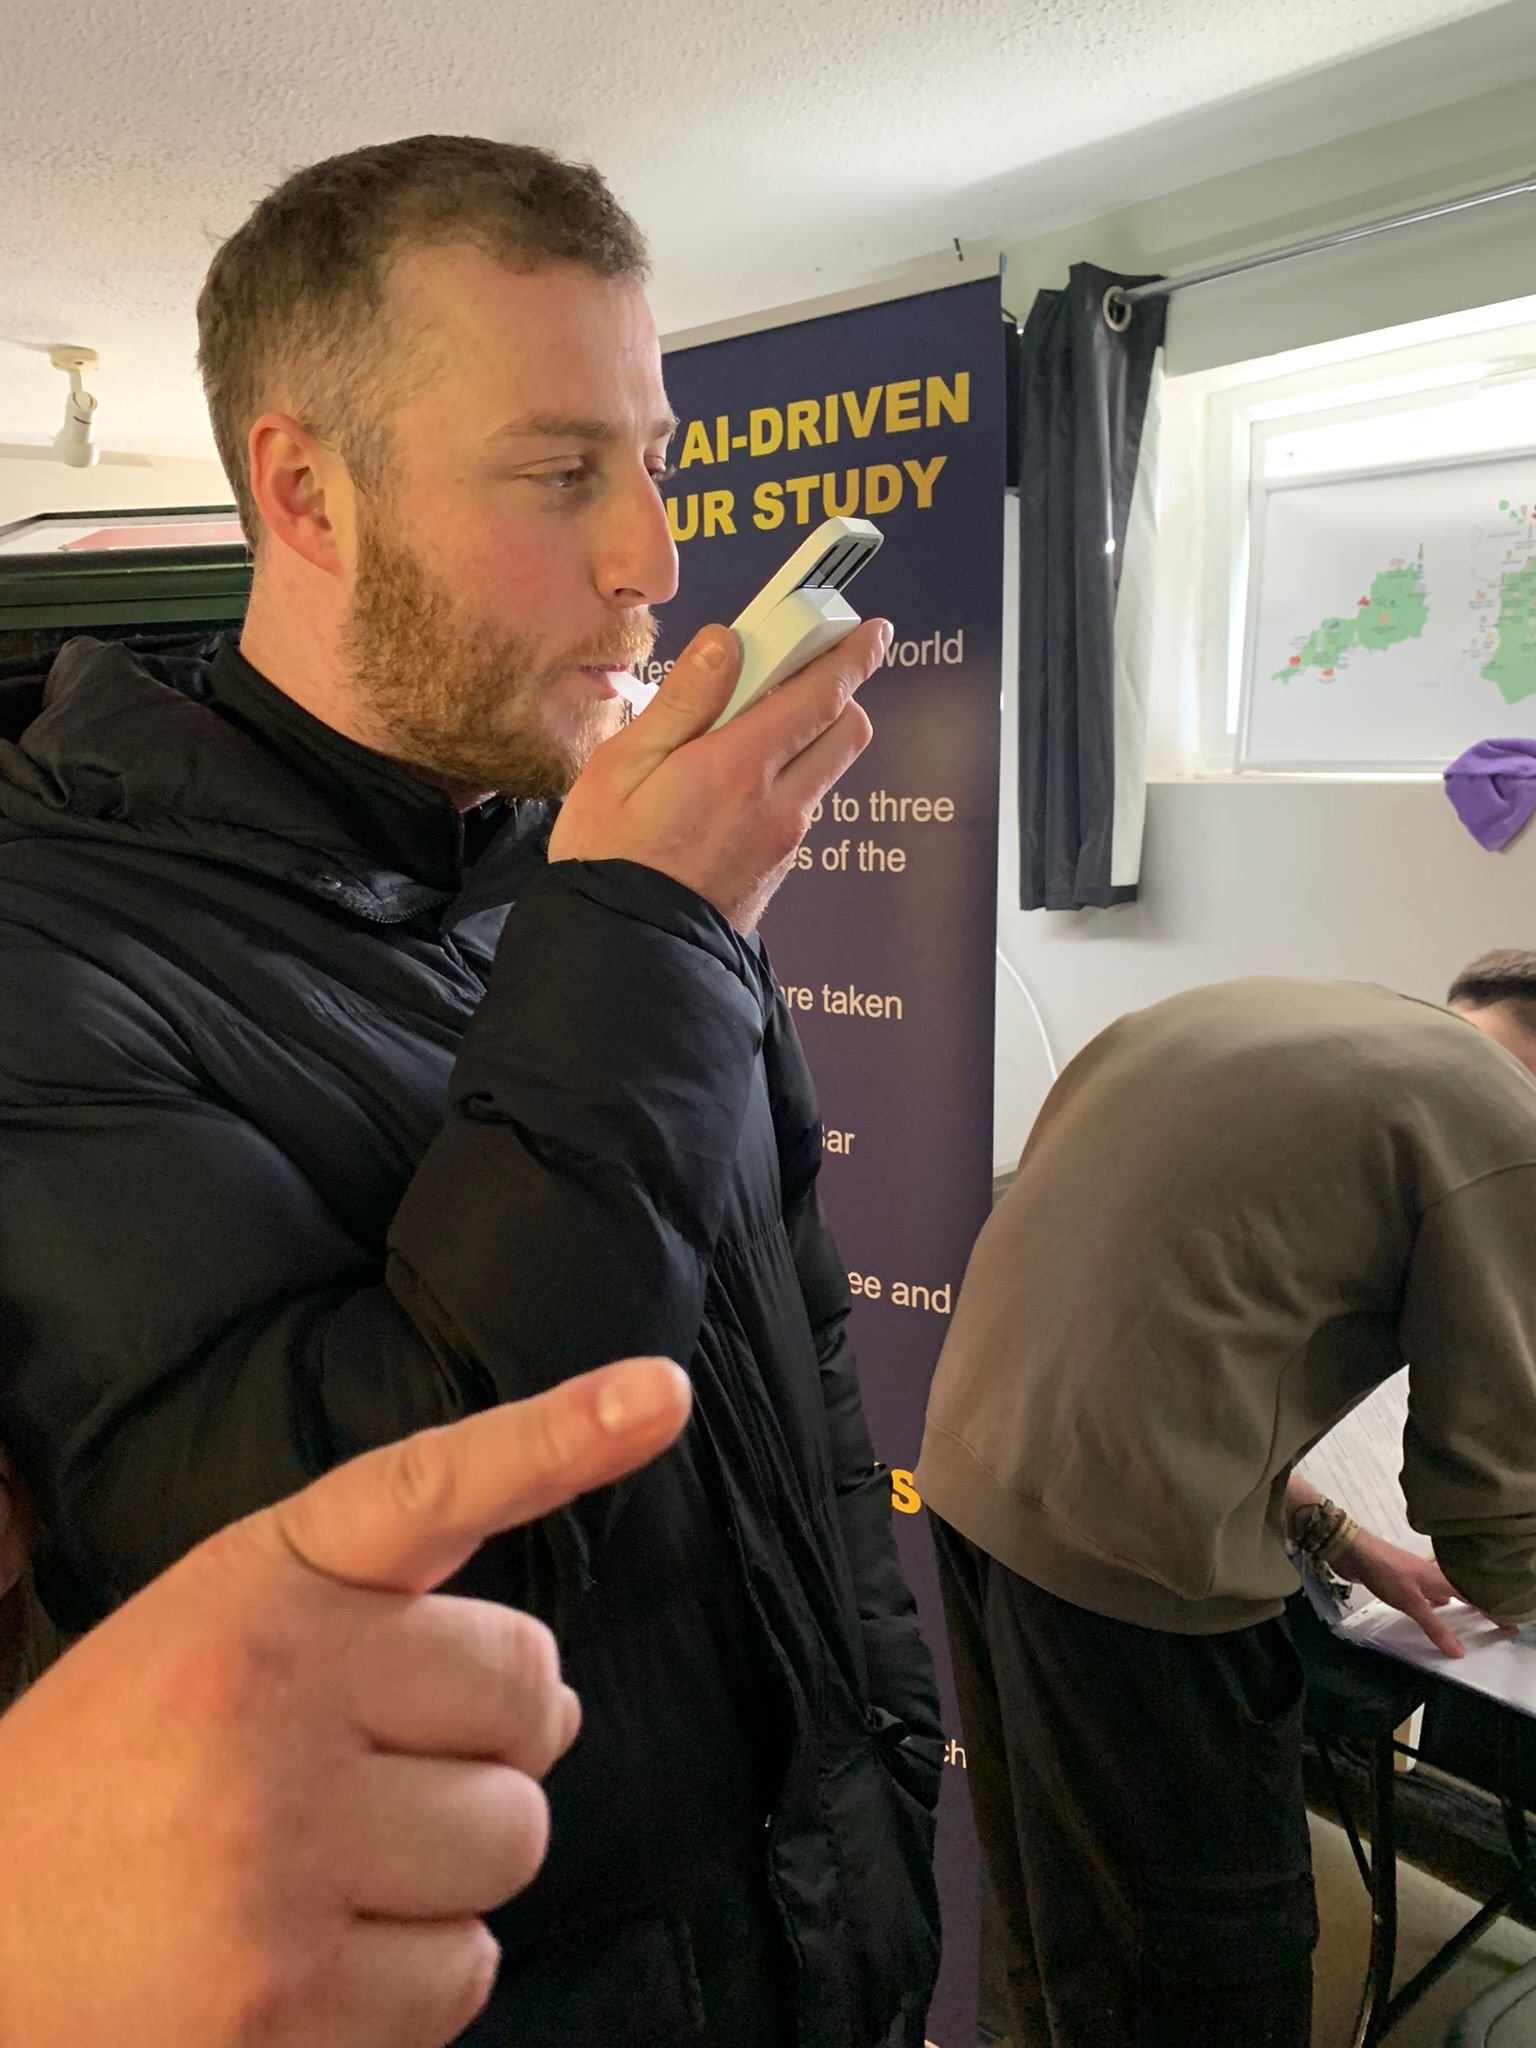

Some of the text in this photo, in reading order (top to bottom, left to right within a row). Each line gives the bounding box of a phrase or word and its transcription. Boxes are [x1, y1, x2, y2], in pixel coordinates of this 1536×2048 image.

[679, 372, 970, 469] AI-DRIVEN
[753, 456, 948, 531] STUDY
[832, 792, 860, 822] to
[869, 790, 955, 823] three
[788, 839, 907, 873] s of the
[822, 983, 903, 1020] taken
[821, 1123, 856, 1156] ar
[891, 1281, 951, 1315] and
